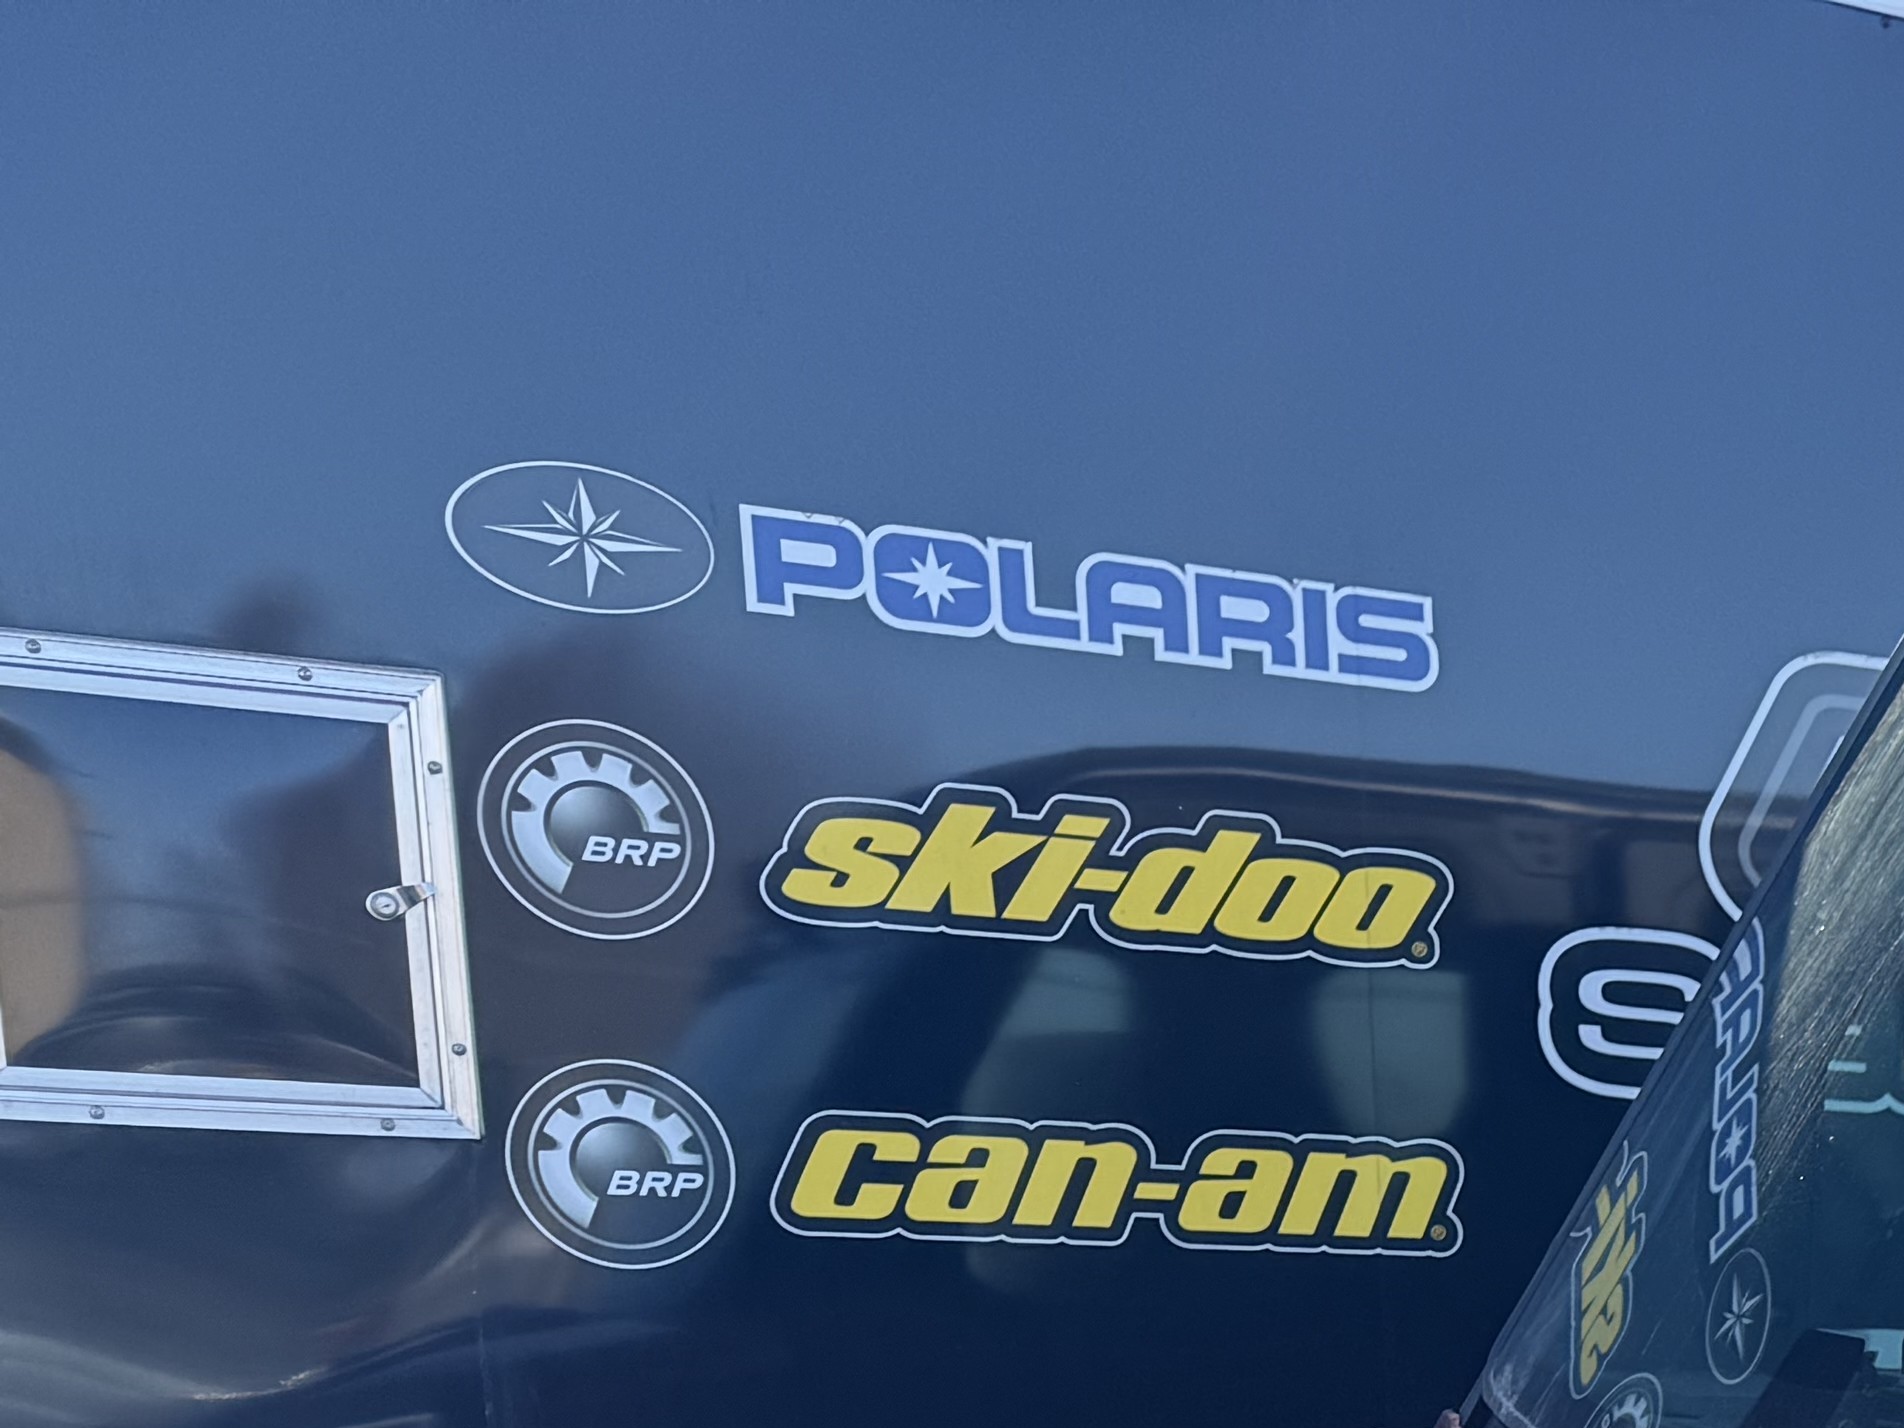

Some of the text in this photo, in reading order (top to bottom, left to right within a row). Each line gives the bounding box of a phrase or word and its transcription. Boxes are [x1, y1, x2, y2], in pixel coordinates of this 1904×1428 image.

[737, 503, 1440, 693] POLARIS
[581, 835, 682, 867] BRP
[780, 803, 1437, 949] ski-doo
[607, 1170, 704, 1198] BRP
[788, 1126, 1449, 1239] can-am
